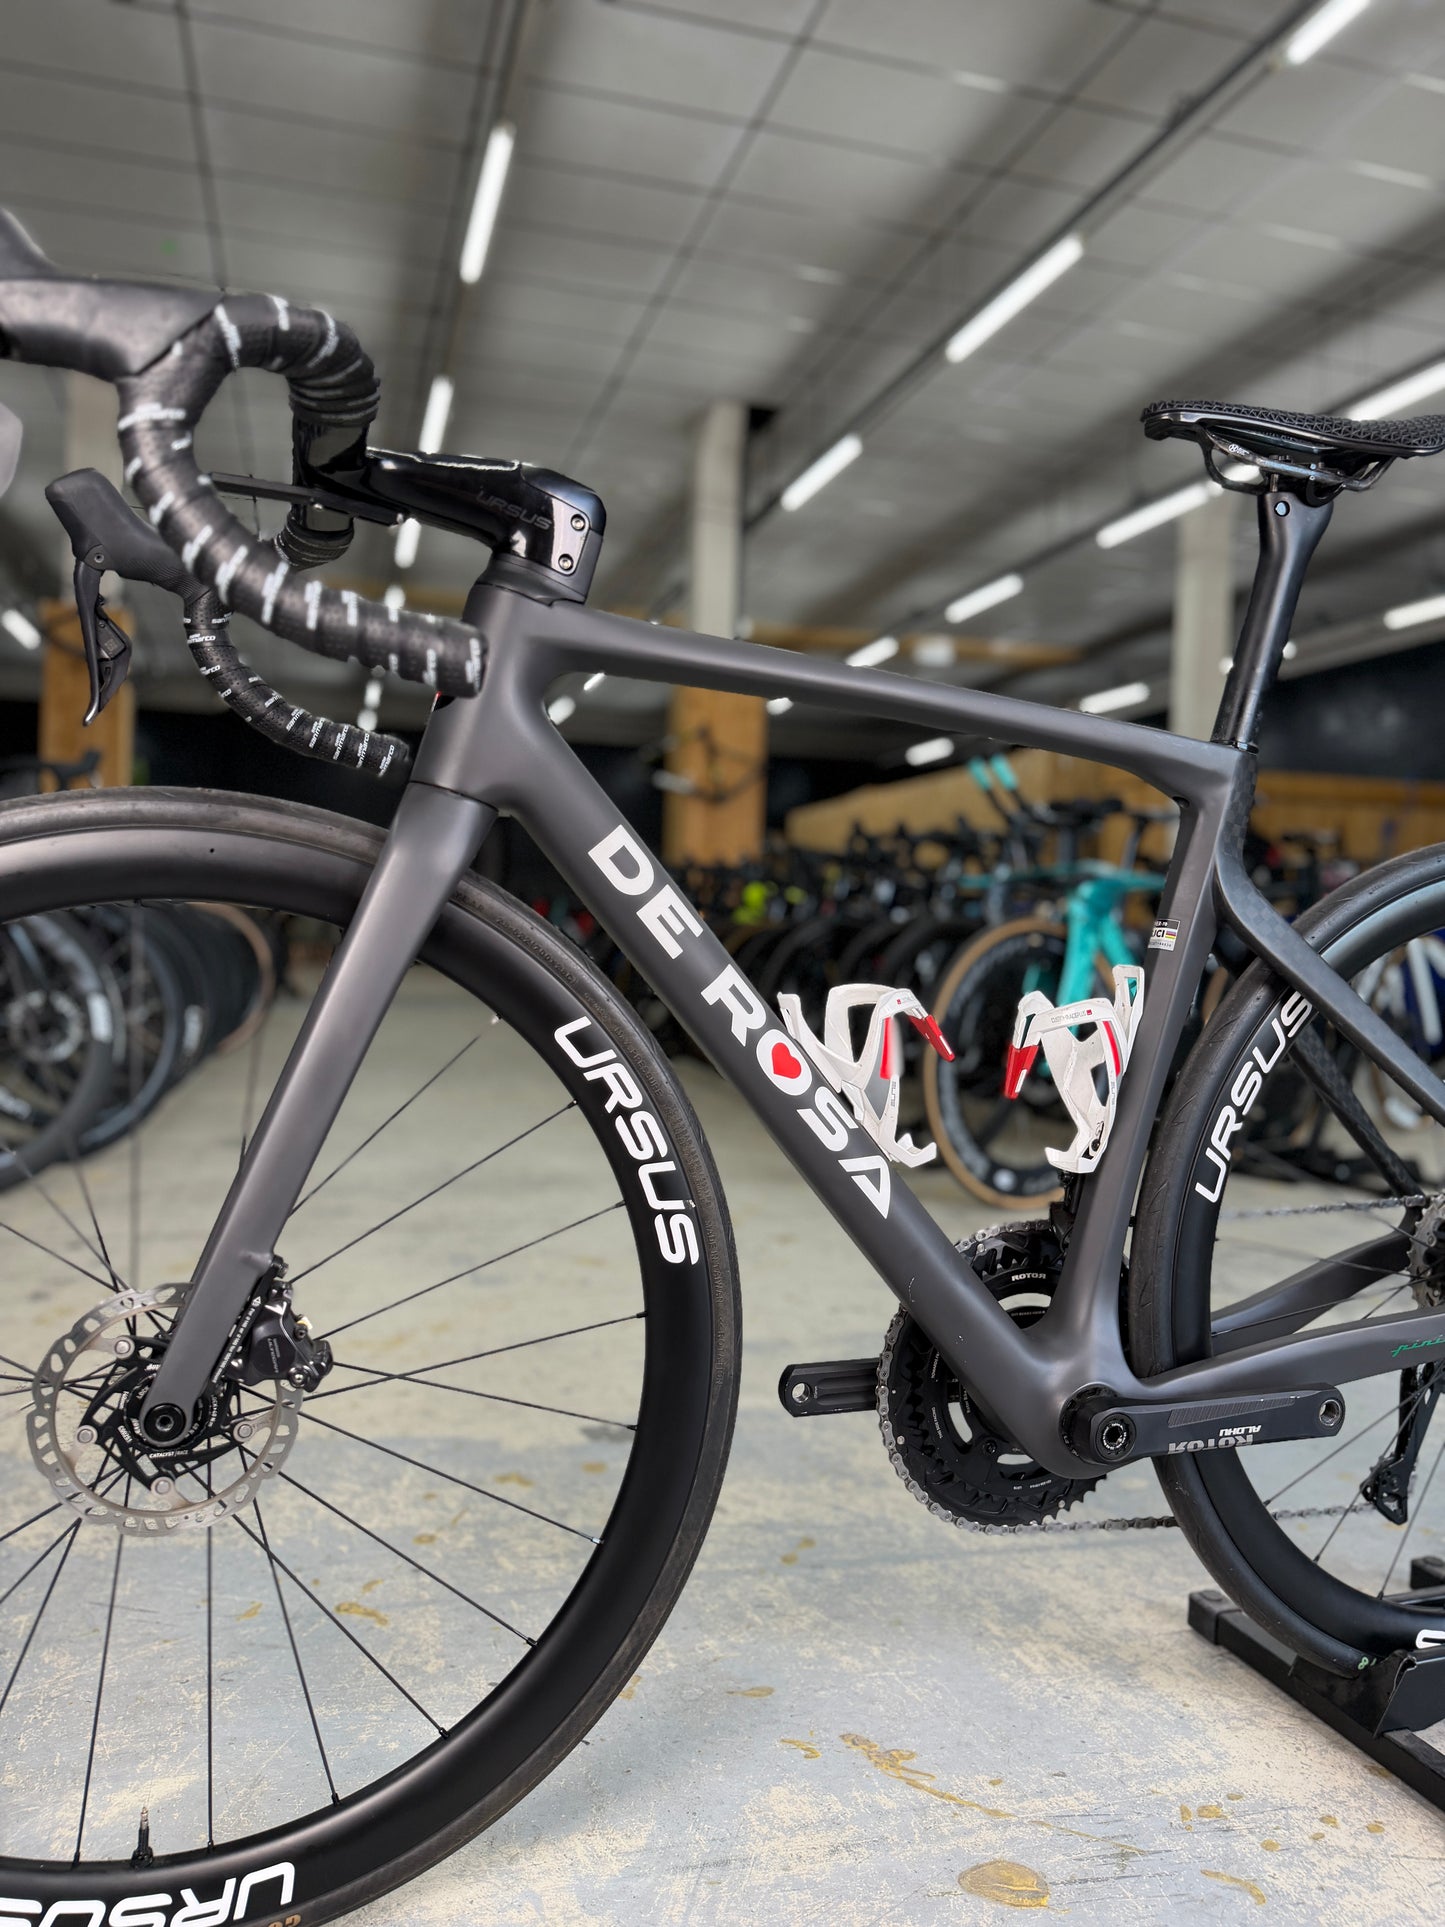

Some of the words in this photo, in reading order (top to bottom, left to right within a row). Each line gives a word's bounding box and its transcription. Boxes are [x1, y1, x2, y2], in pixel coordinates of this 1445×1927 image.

[476, 486, 553, 531] URSUS
[587, 824, 703, 960] DE
[700, 963, 892, 1219] ROSA
[1195, 991, 1313, 1204] URSUS
[553, 1015, 700, 1266] URSUS
[1011, 1272, 1047, 1282] ROTOR
[1168, 1434, 1254, 1455] ROTOR
[1219, 1424, 1262, 1437] ALDHU
